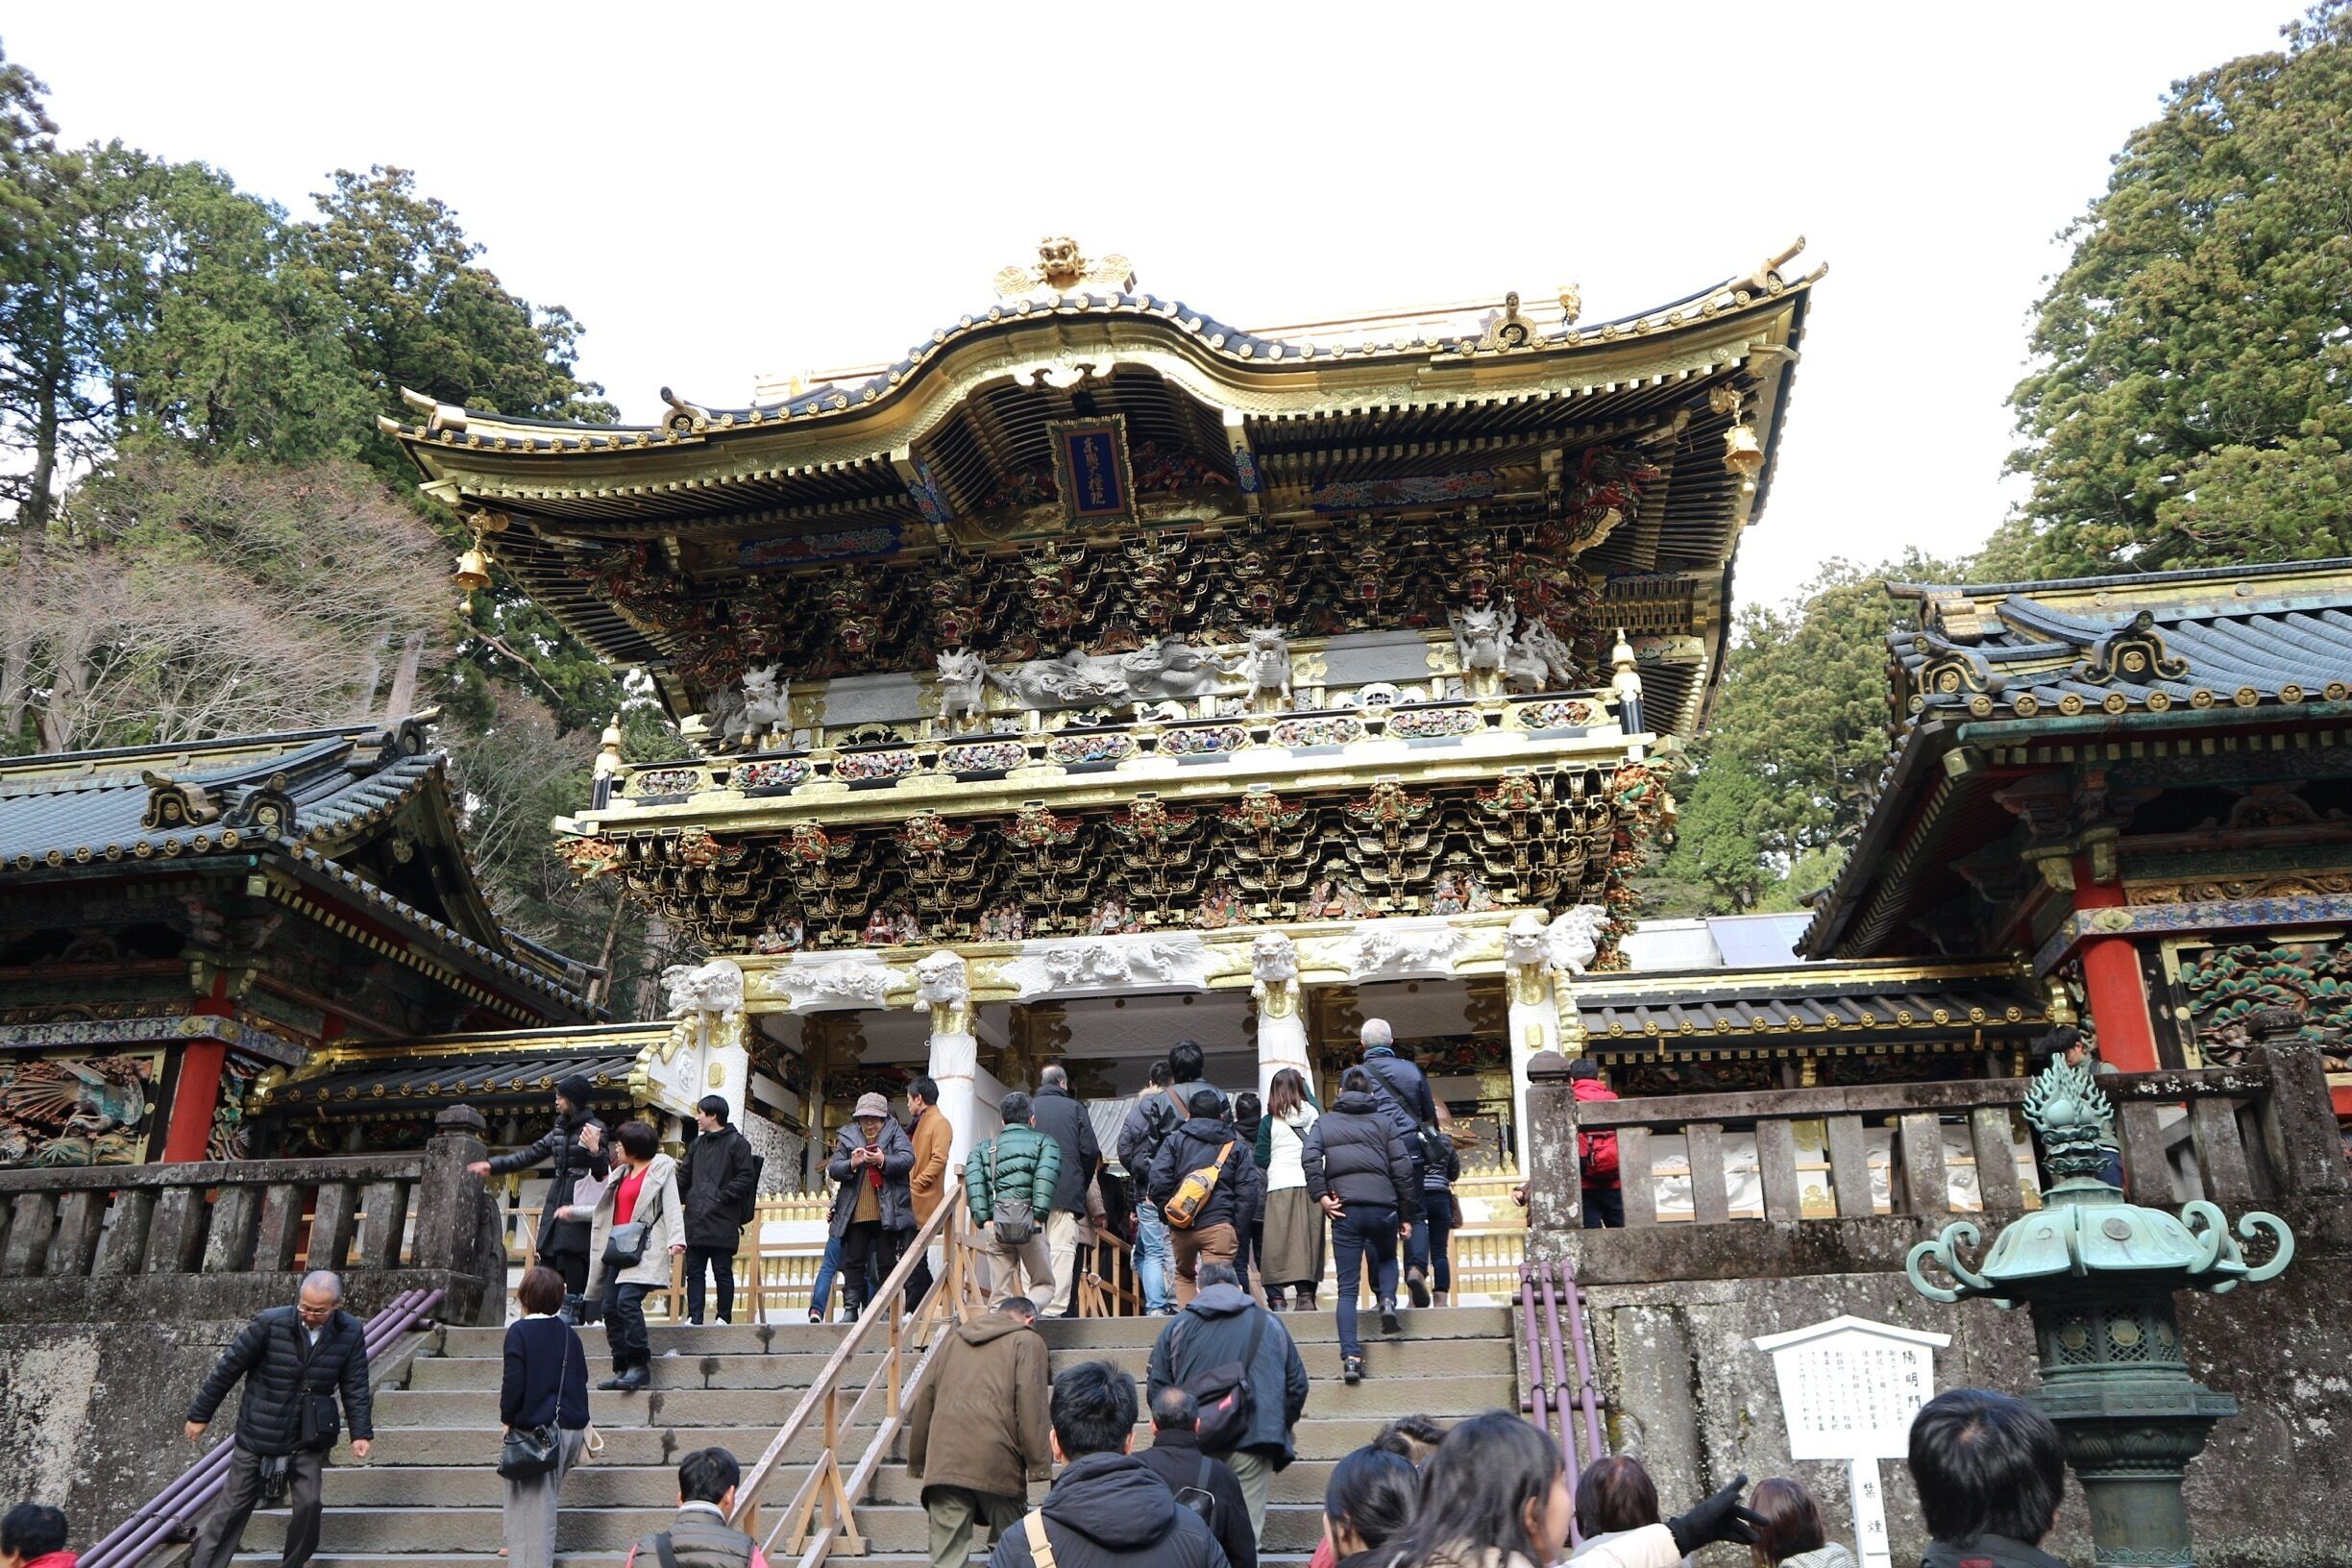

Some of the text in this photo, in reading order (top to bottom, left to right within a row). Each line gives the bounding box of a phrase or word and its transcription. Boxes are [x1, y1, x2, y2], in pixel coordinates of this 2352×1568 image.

[1902, 1350, 1922, 1409] 陽明門
[1863, 1482, 1882, 1533] 禁煙
